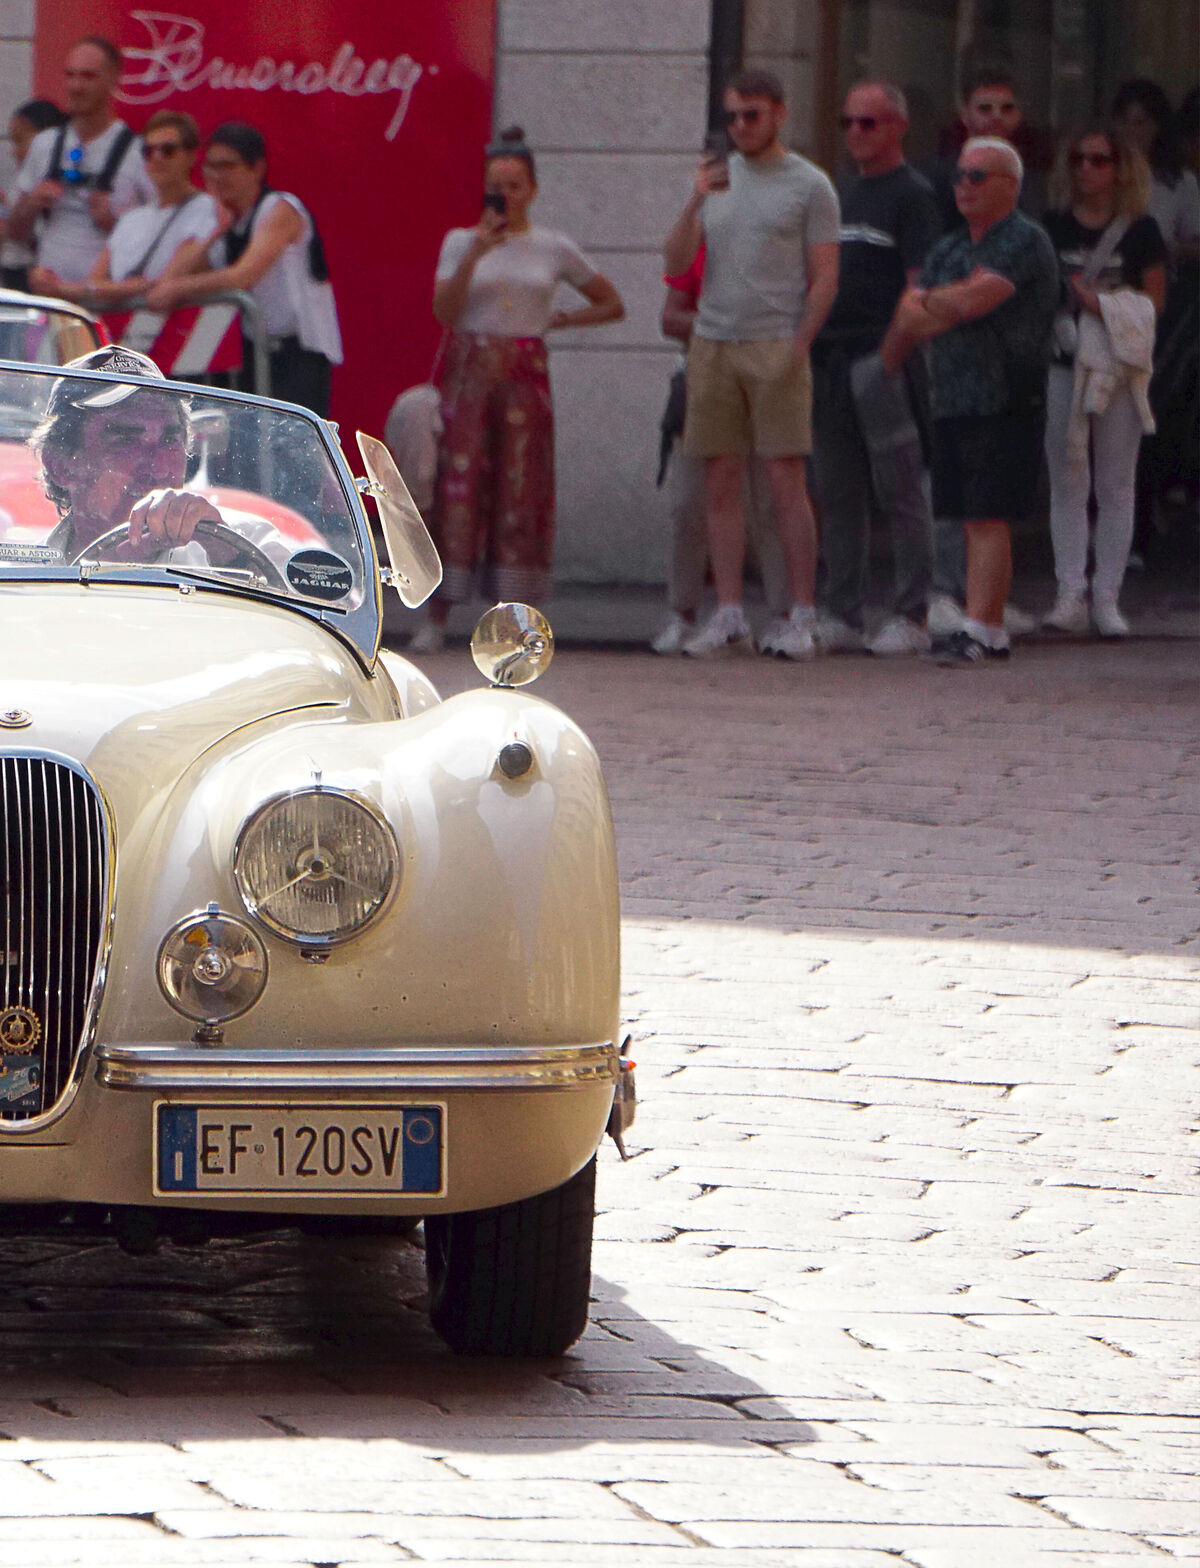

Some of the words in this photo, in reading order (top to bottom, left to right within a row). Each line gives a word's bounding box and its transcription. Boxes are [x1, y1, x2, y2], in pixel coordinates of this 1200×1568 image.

[28, 549, 58, 558] ASTON
[291, 577, 350, 590] JAGUAR
[201, 1124, 252, 1175] EF
[273, 1126, 400, 1177] 120SV
